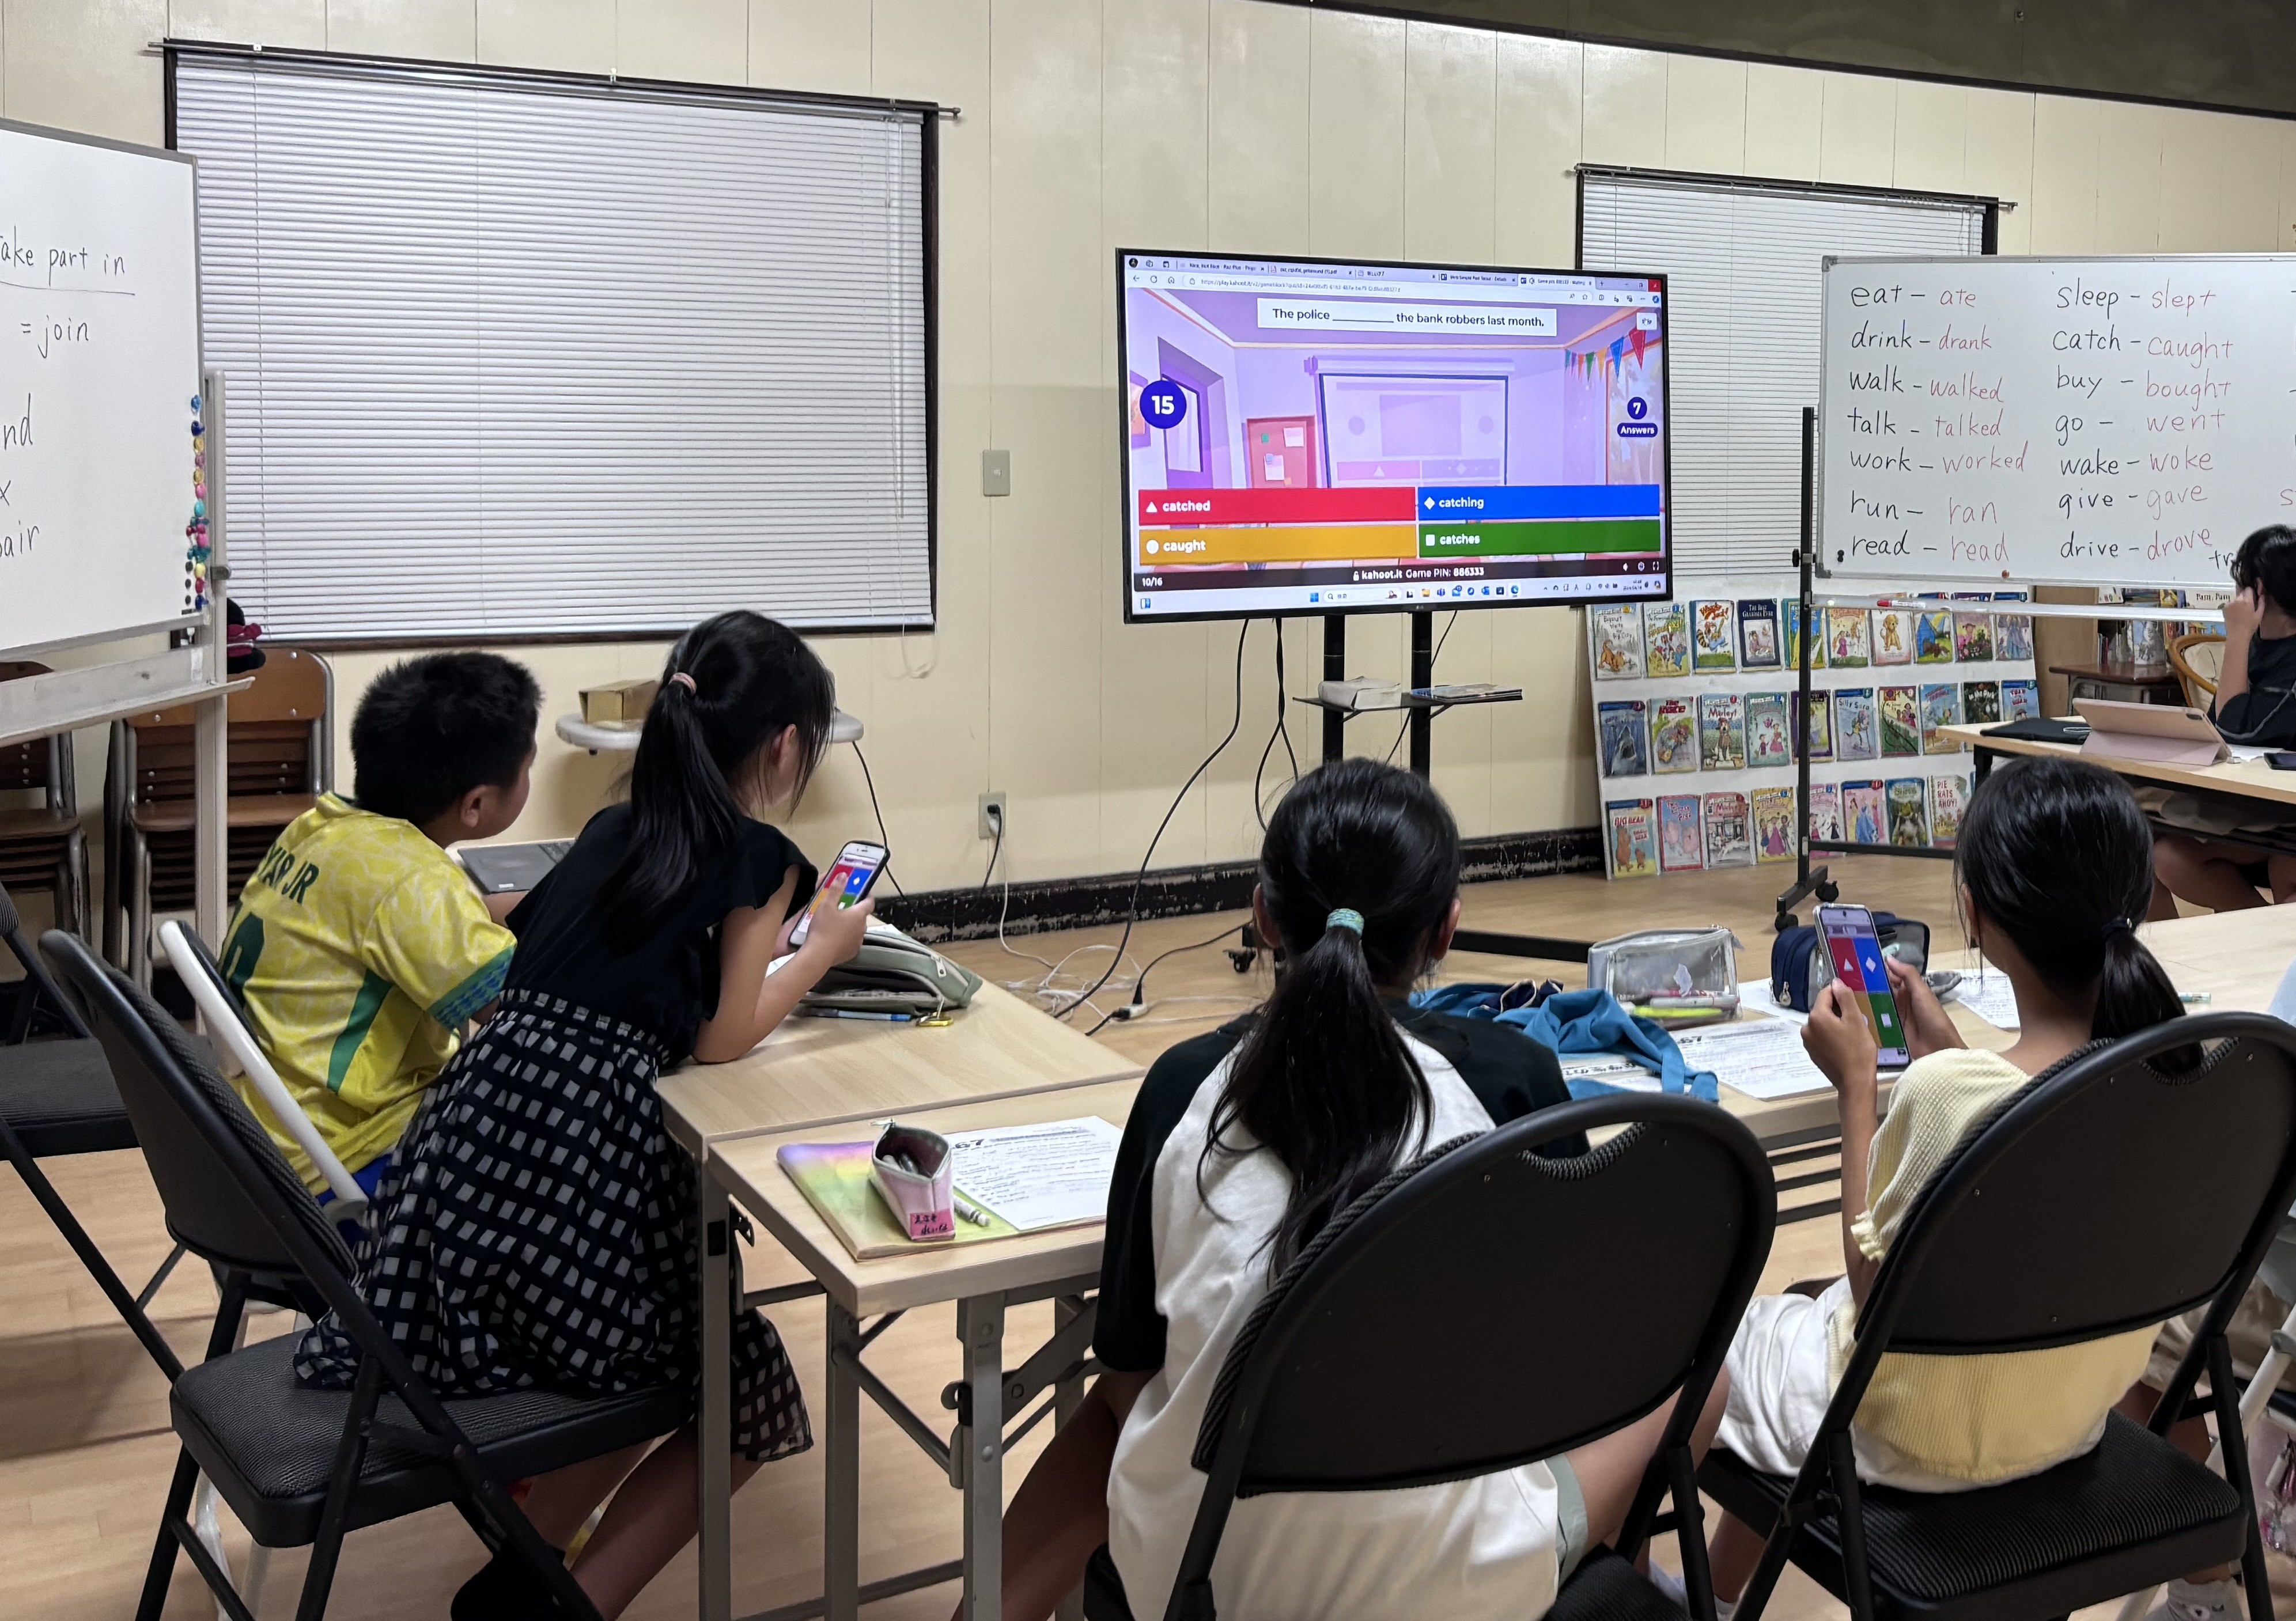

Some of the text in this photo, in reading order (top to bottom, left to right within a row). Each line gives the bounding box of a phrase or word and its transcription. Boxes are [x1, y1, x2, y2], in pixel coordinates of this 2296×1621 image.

[0, 225, 125, 287] ake part in
[1851, 285, 1902, 307] eat
[1940, 289, 1976, 308] ate
[2152, 279, 2216, 316] slept
[1273, 308, 1544, 327] The police the bank robbers last month.
[1851, 319, 1912, 349] drink
[1939, 323, 1992, 350] drank
[2148, 331, 2234, 371] caught
[1849, 365, 1904, 393] walk
[1930, 373, 2004, 403] walked
[2057, 364, 2102, 399] buy
[2146, 368, 2231, 412] bought
[1151, 395, 1175, 415] 15
[1632, 402, 1642, 415] 7
[3, 392, 33, 450] nd
[1620, 425, 1655, 434] Answers
[1847, 407, 1896, 435] talk
[1935, 408, 2003, 438] talked
[2055, 415, 2083, 446] go
[2147, 408, 2225, 432] went
[1850, 446, 1912, 472] work
[1942, 440, 2028, 474] worked
[2060, 448, 2119, 476] wake
[2150, 445, 2213, 472] woke
[1162, 500, 1211, 512] catched
[1439, 497, 1485, 510] catching
[1851, 490, 1899, 520] run
[1949, 497, 1997, 525] ran
[2059, 487, 2113, 520] give
[2147, 485, 2208, 519] gave
[1163, 540, 1206, 553] caught
[1439, 534, 1481, 545] catches
[1852, 529, 1911, 556] read
[1951, 532, 2009, 562] read
[2060, 531, 2118, 558] drive
[2147, 528, 2215, 560] drove
[1142, 577, 1163, 588] 10/16
[1361, 567, 1485, 580] kahoot.it Game PIN: 886333
[282, 861, 320, 904] JR
